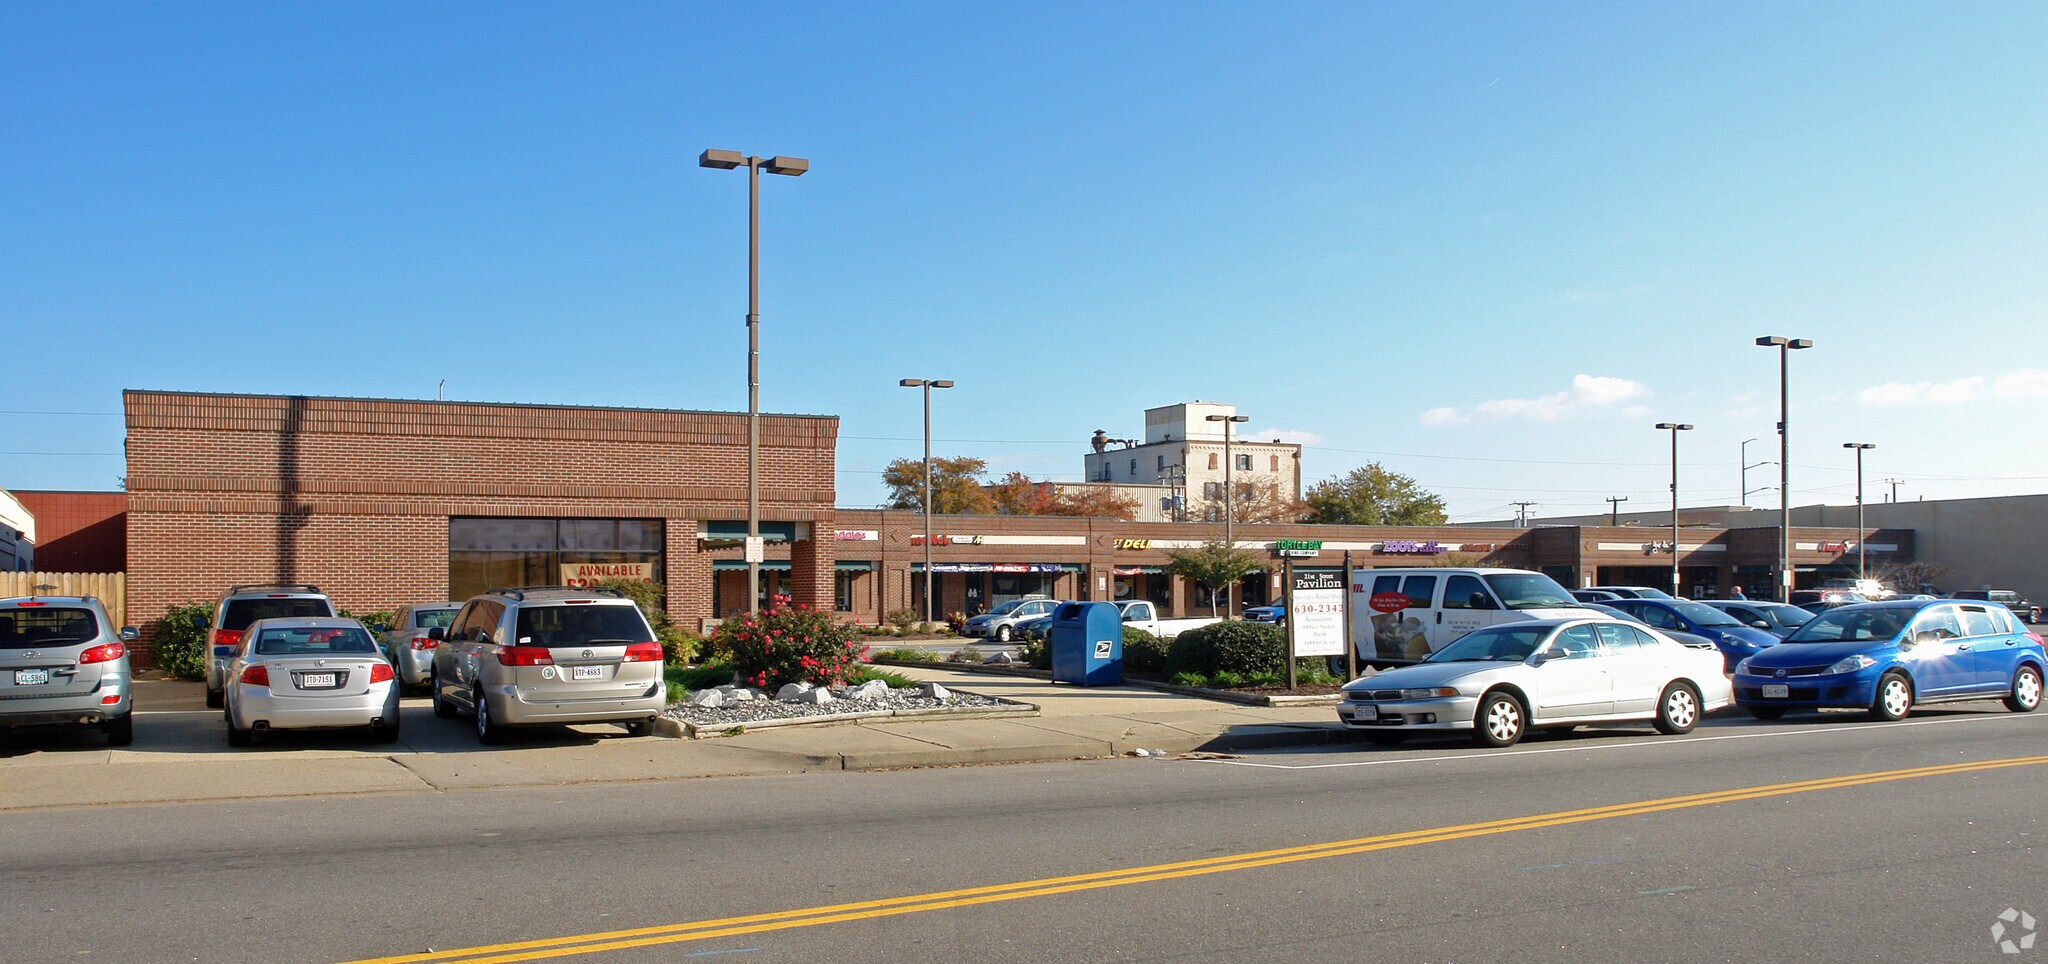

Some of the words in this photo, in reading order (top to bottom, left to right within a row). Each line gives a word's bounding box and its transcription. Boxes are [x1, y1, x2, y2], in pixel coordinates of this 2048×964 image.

[1123, 539, 1152, 549] DELI
[1276, 539, 1307, 550] TURTLE
[1307, 540, 1323, 550] BAY
[1382, 541, 1418, 553] ZOOTS
[579, 565, 642, 576] AVAILABLE
[1296, 578, 1342, 589] Pavilion
[1294, 603, 1345, 613] 630-2342
[306, 675, 333, 684] JTD-7151
